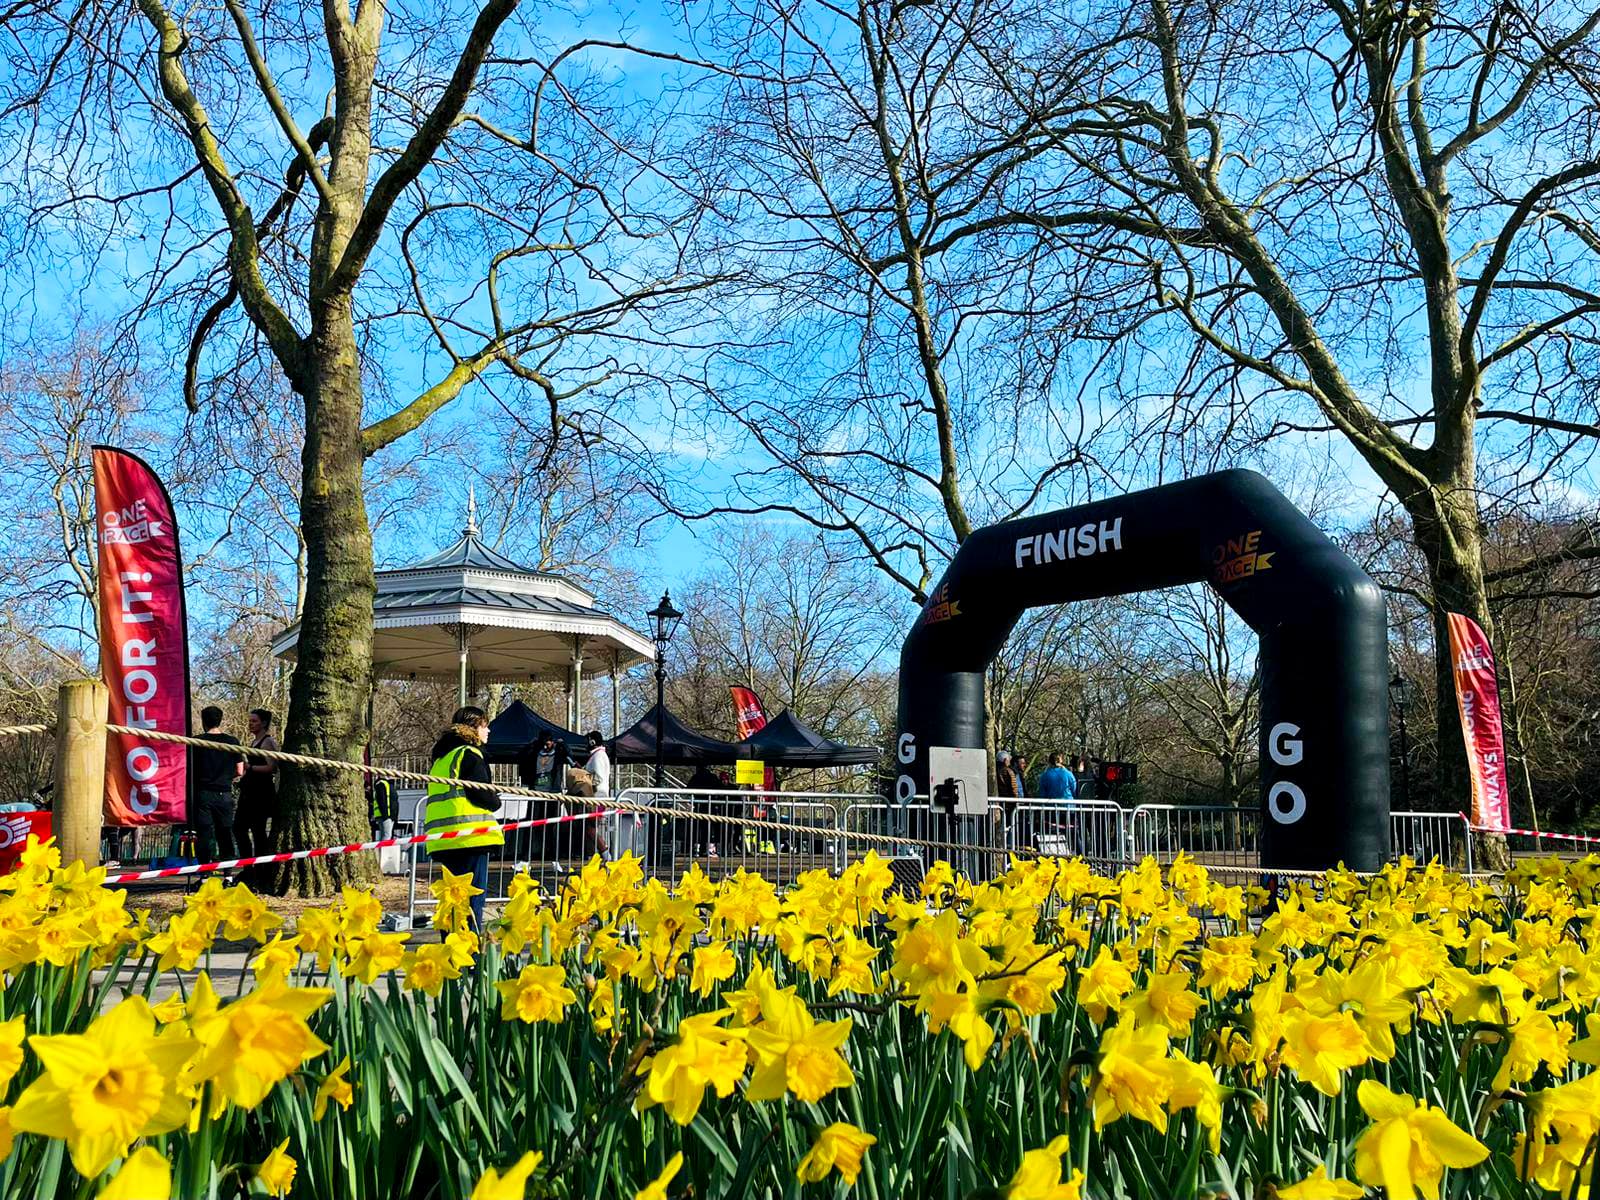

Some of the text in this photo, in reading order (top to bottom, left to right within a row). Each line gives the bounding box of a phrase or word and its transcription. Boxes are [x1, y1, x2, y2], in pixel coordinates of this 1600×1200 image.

[102, 520, 151, 545] RACE
[103, 498, 147, 527] ONE
[1015, 517, 1123, 568] FINISH
[1212, 530, 1262, 563] ONE
[923, 601, 952, 625] ACE
[928, 582, 949, 607] NE
[121, 571, 160, 815] GO FOR IT!
[896, 732, 916, 804] GO
[1268, 722, 1307, 824] GO
[1484, 752, 1503, 829] ALWAYS
